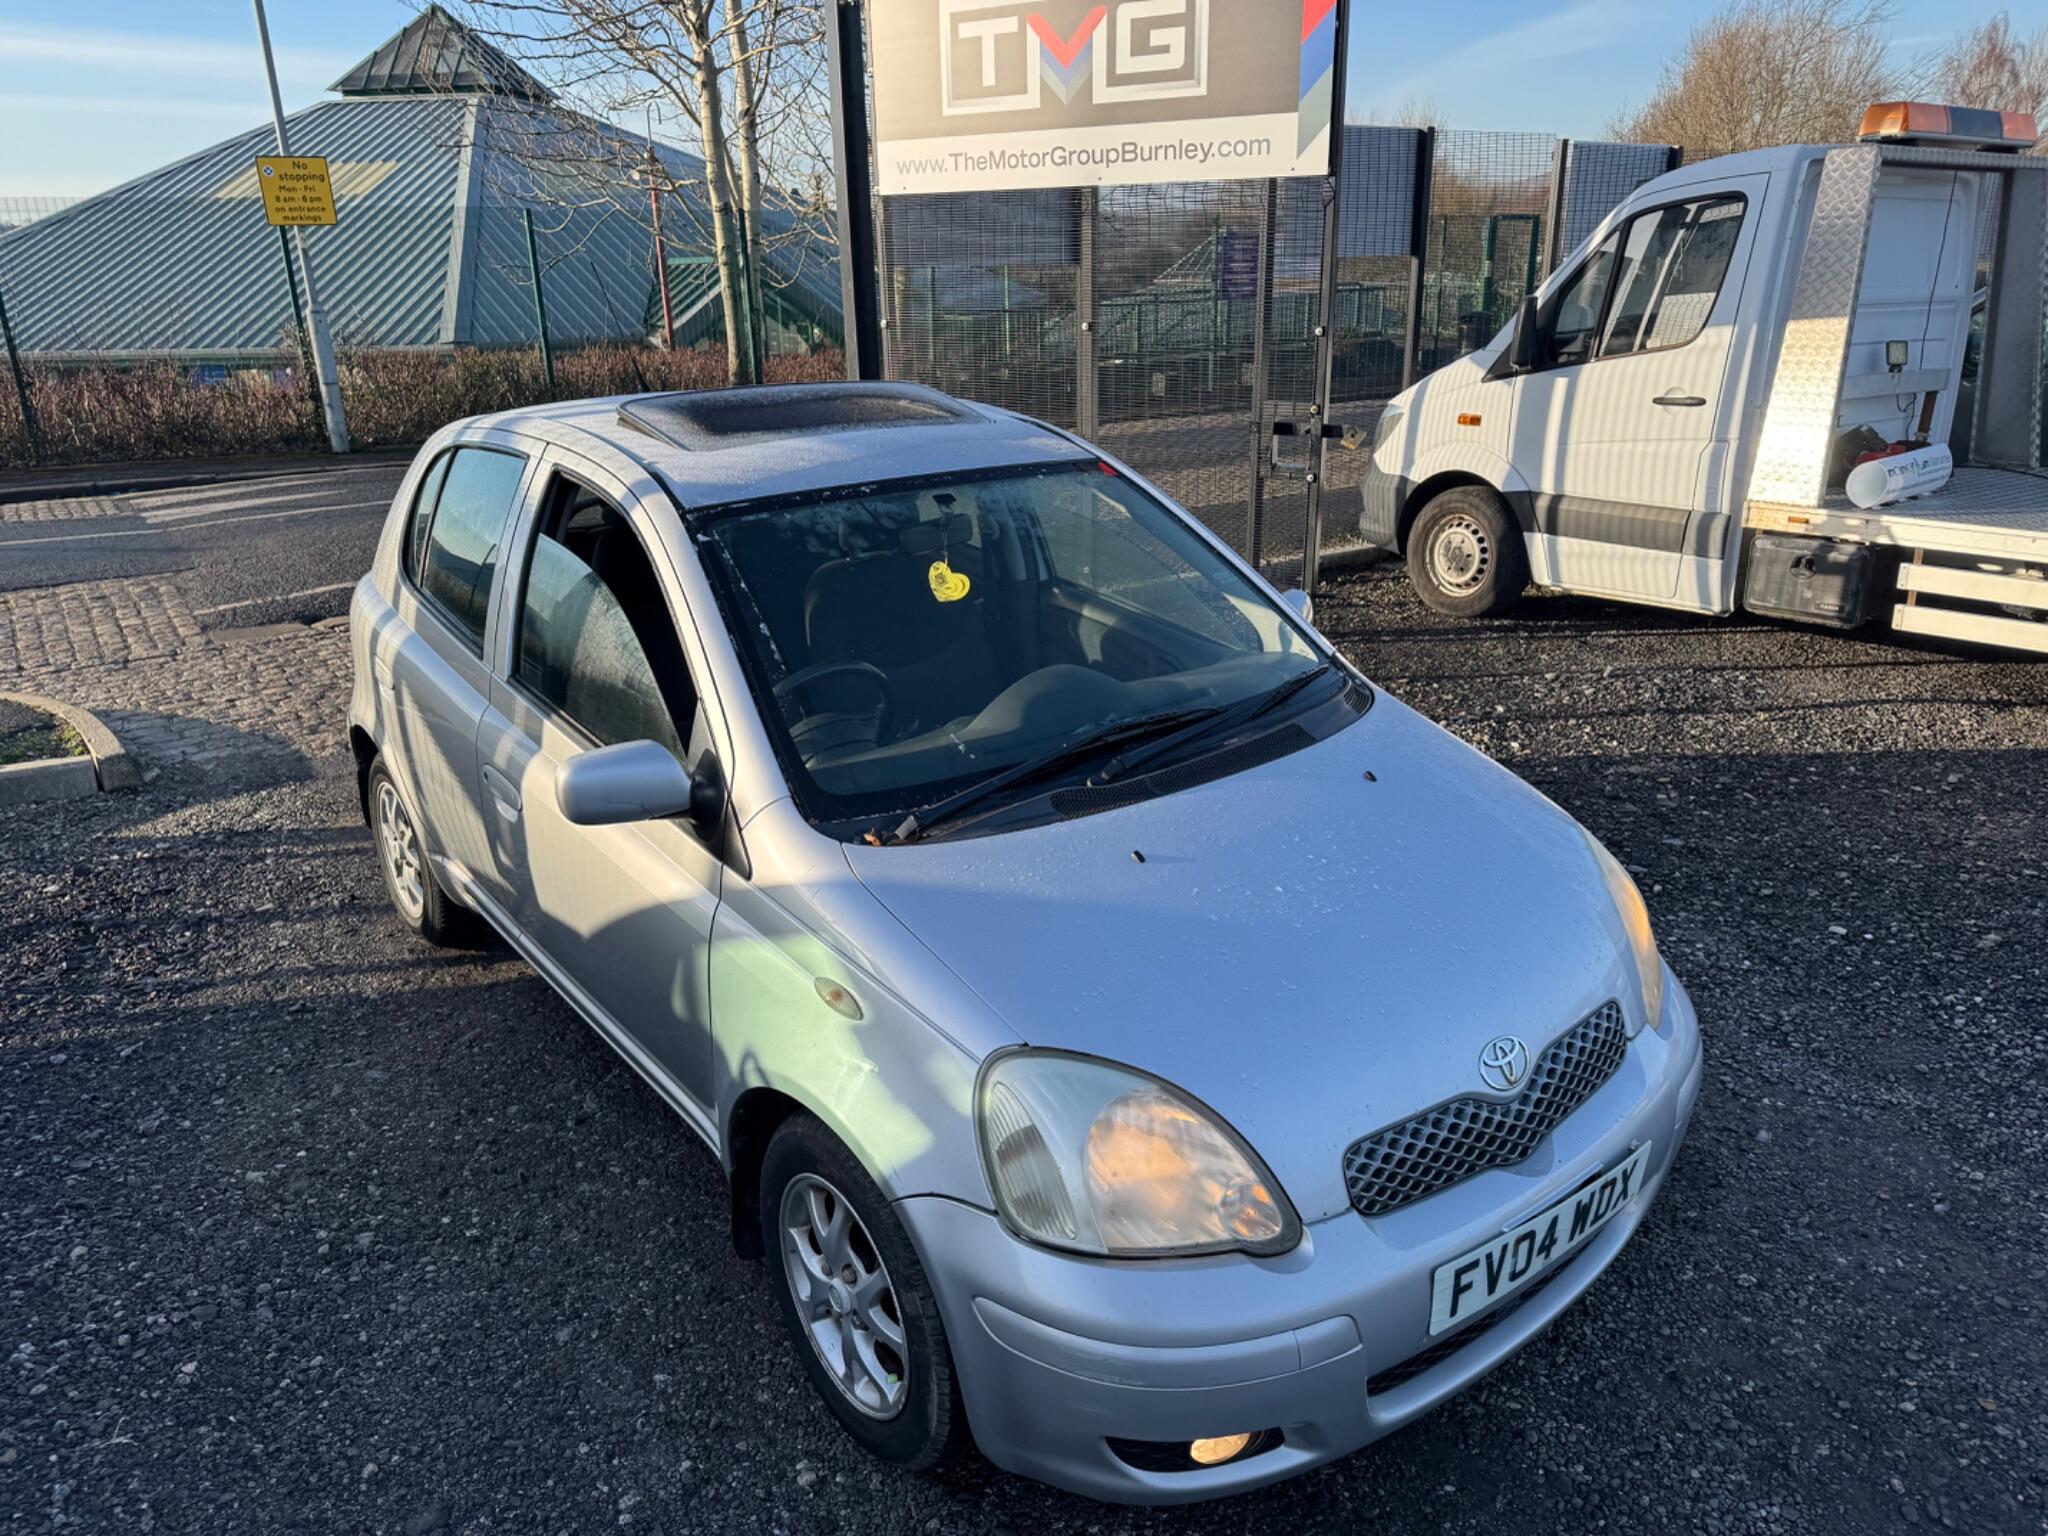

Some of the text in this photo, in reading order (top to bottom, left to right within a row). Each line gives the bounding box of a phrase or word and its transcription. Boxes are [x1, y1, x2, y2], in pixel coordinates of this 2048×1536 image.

[956, 1, 1188, 106] TMG
[896, 136, 1272, 176] www.TheMotorGroupBurnley.com
[292, 160, 308, 170] No
[279, 172, 325, 183] stopping
[278, 185, 298, 193] Mon
[303, 184, 316, 193] Fri
[309, 196, 323, 204] pm
[288, 205, 326, 213] entrance
[282, 214, 322, 222] markings
[1449, 1158, 1639, 1318] FV04 WDX
